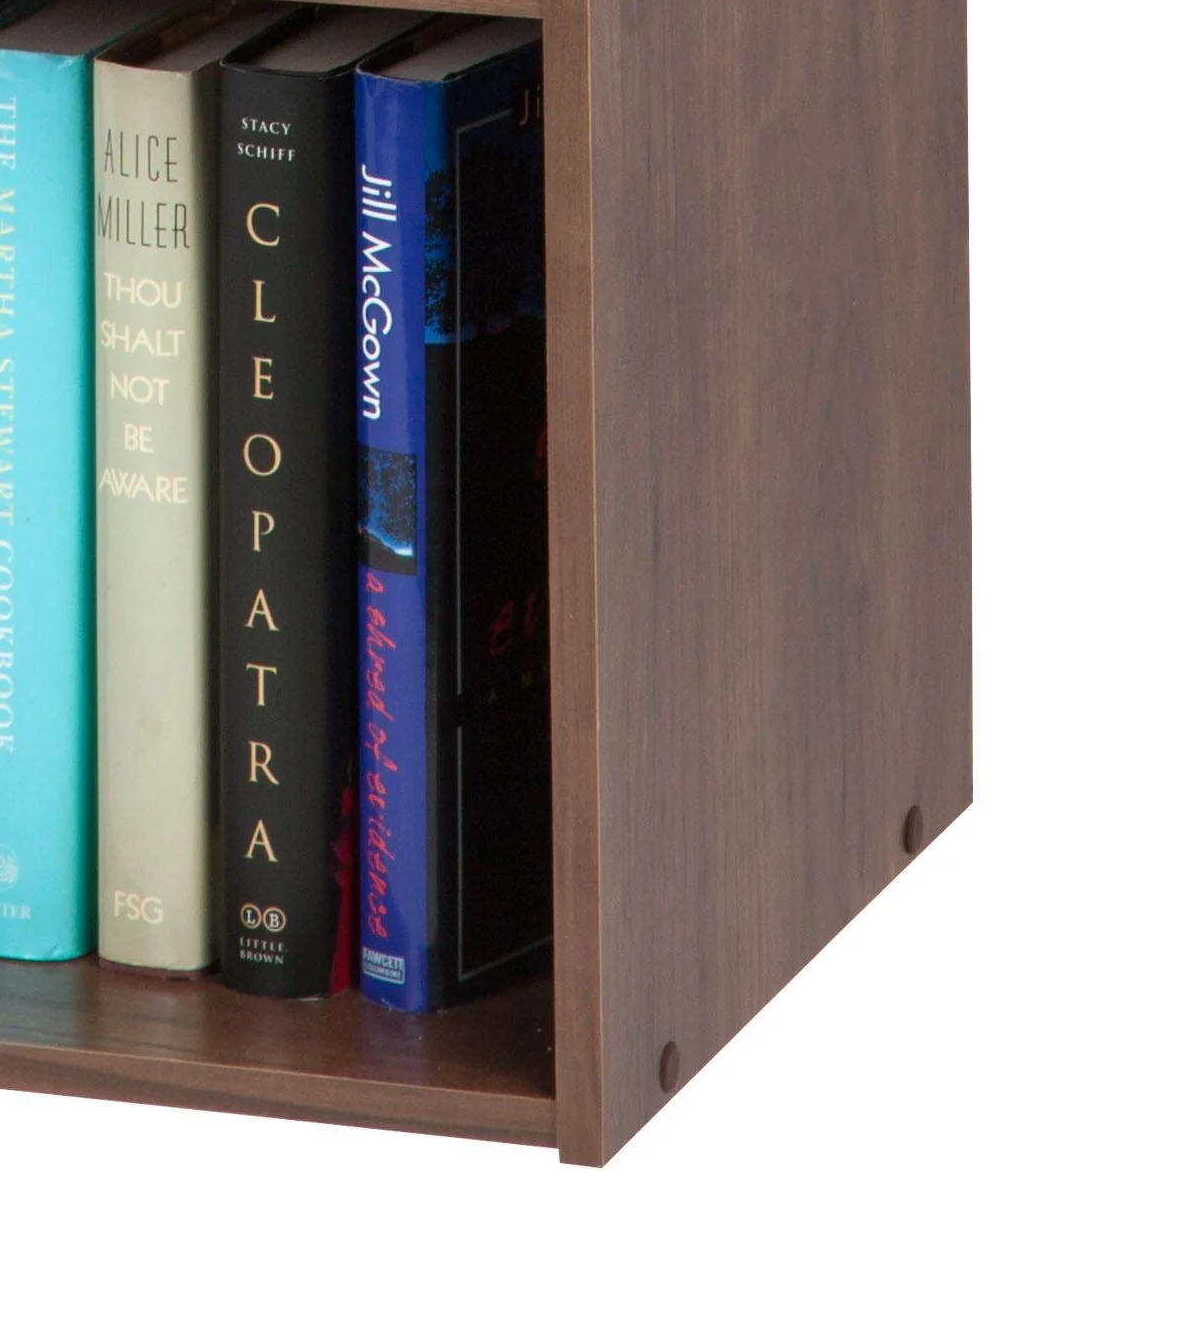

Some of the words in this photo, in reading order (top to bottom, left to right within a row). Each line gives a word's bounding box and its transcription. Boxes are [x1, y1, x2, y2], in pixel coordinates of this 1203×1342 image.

[240, 116, 293, 136] STACY
[104, 128, 179, 183] ALICE
[237, 143, 296, 163] SCHIFF
[362, 165, 397, 222] Jill
[97, 192, 190, 250] MILLER
[103, 272, 183, 310] THOU
[100, 320, 186, 358] SHALT
[362, 231, 392, 419] McGown
[110, 370, 170, 406] NOT
[123, 423, 154, 453] BE
[98, 467, 189, 504] AWARE
[242, 202, 282, 863] CLEOPATRA
[366, 572, 384, 594] a
[113, 890, 164, 924] FSG
[239, 948, 285, 966] BROWN
[362, 947, 405, 972] FAWCETT
